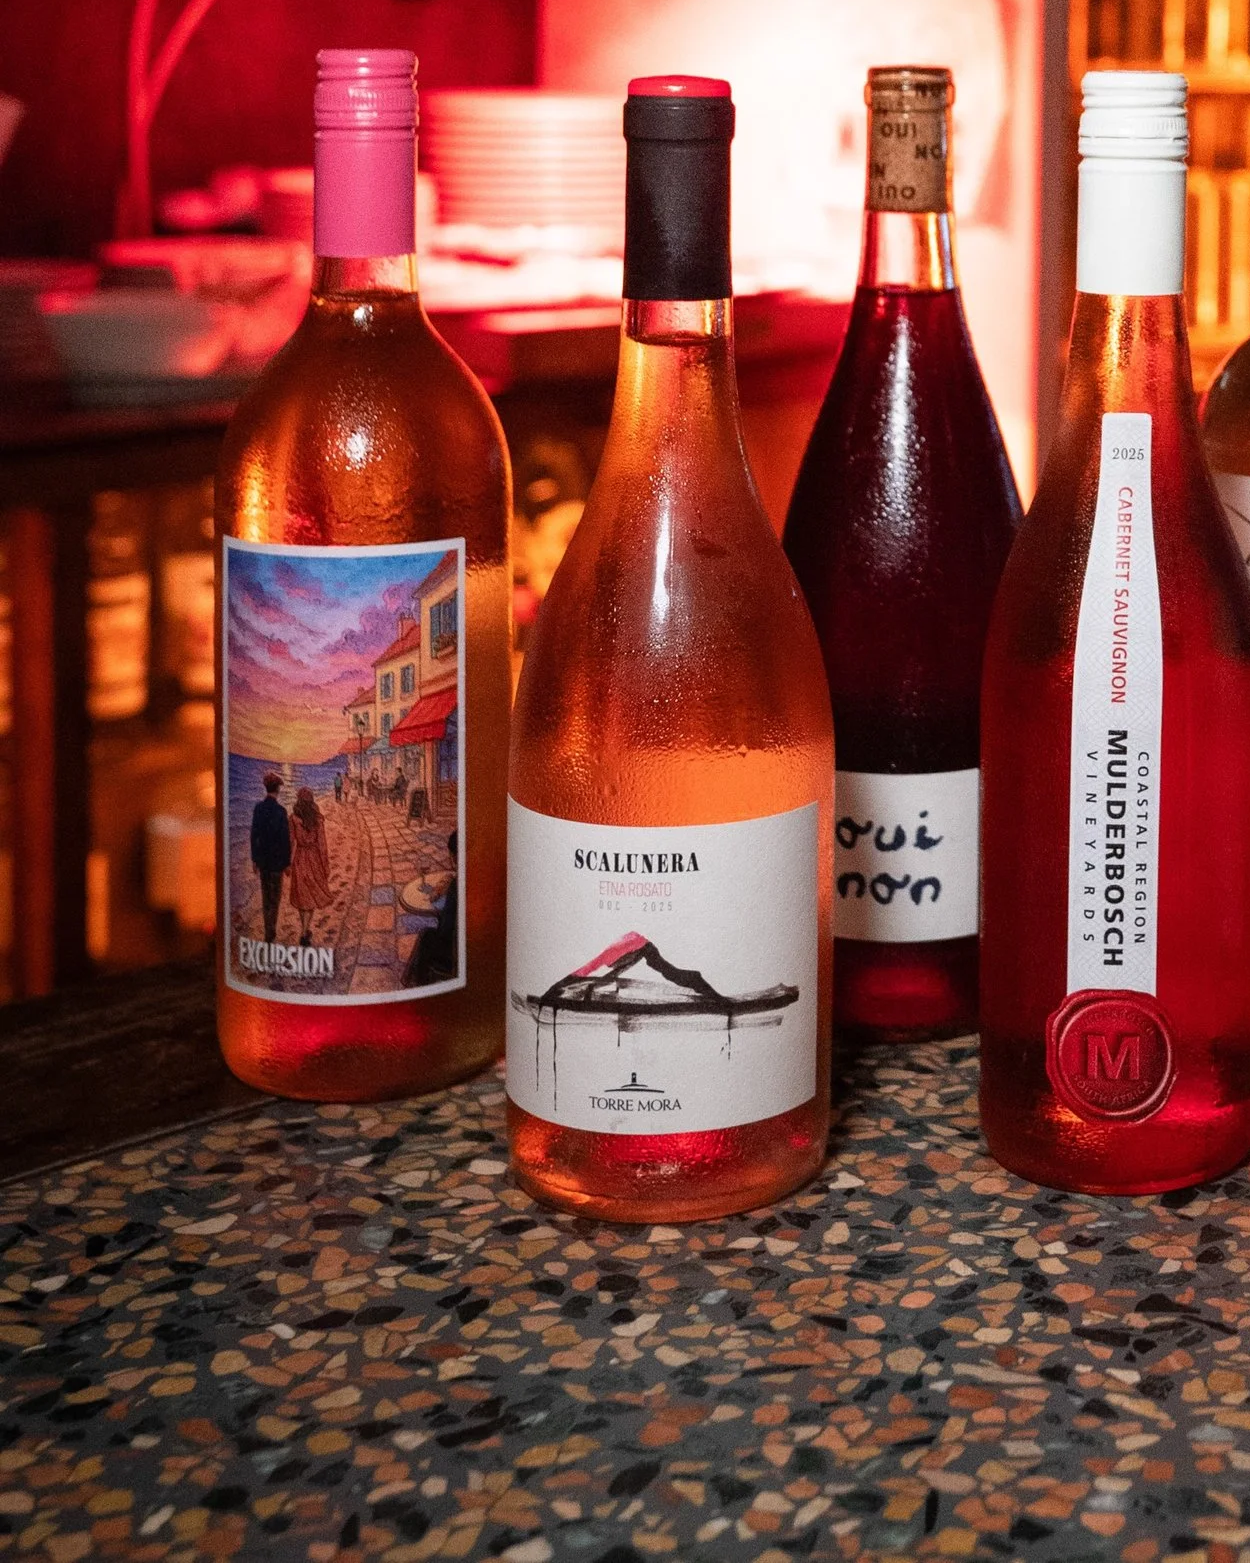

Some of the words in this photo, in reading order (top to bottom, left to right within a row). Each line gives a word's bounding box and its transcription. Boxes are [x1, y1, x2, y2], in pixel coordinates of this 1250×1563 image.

[880, 122, 917, 138] OUI
[1111, 447, 1145, 461] 2025
[1115, 487, 1134, 582] CABERNET
[1110, 588, 1130, 704] SAUVIGNON
[1135, 751, 1150, 849] COASTAL
[835, 810, 945, 852] oui
[1083, 751, 1099, 942] VINEYARDS
[1103, 729, 1129, 967] MULDERBOSCH
[574, 847, 700, 874] SCALUNERA
[599, 880, 625, 897] ETNA
[628, 881, 672, 897] ROSATO
[643, 901, 673, 912] 2025
[837, 871, 942, 905] non
[1134, 862, 1148, 944] REGION
[239, 935, 335, 979] EXCURSION
[1084, 1034, 1141, 1080] M
[588, 1095, 634, 1112] TORRE
[637, 1098, 682, 1112] MORA
